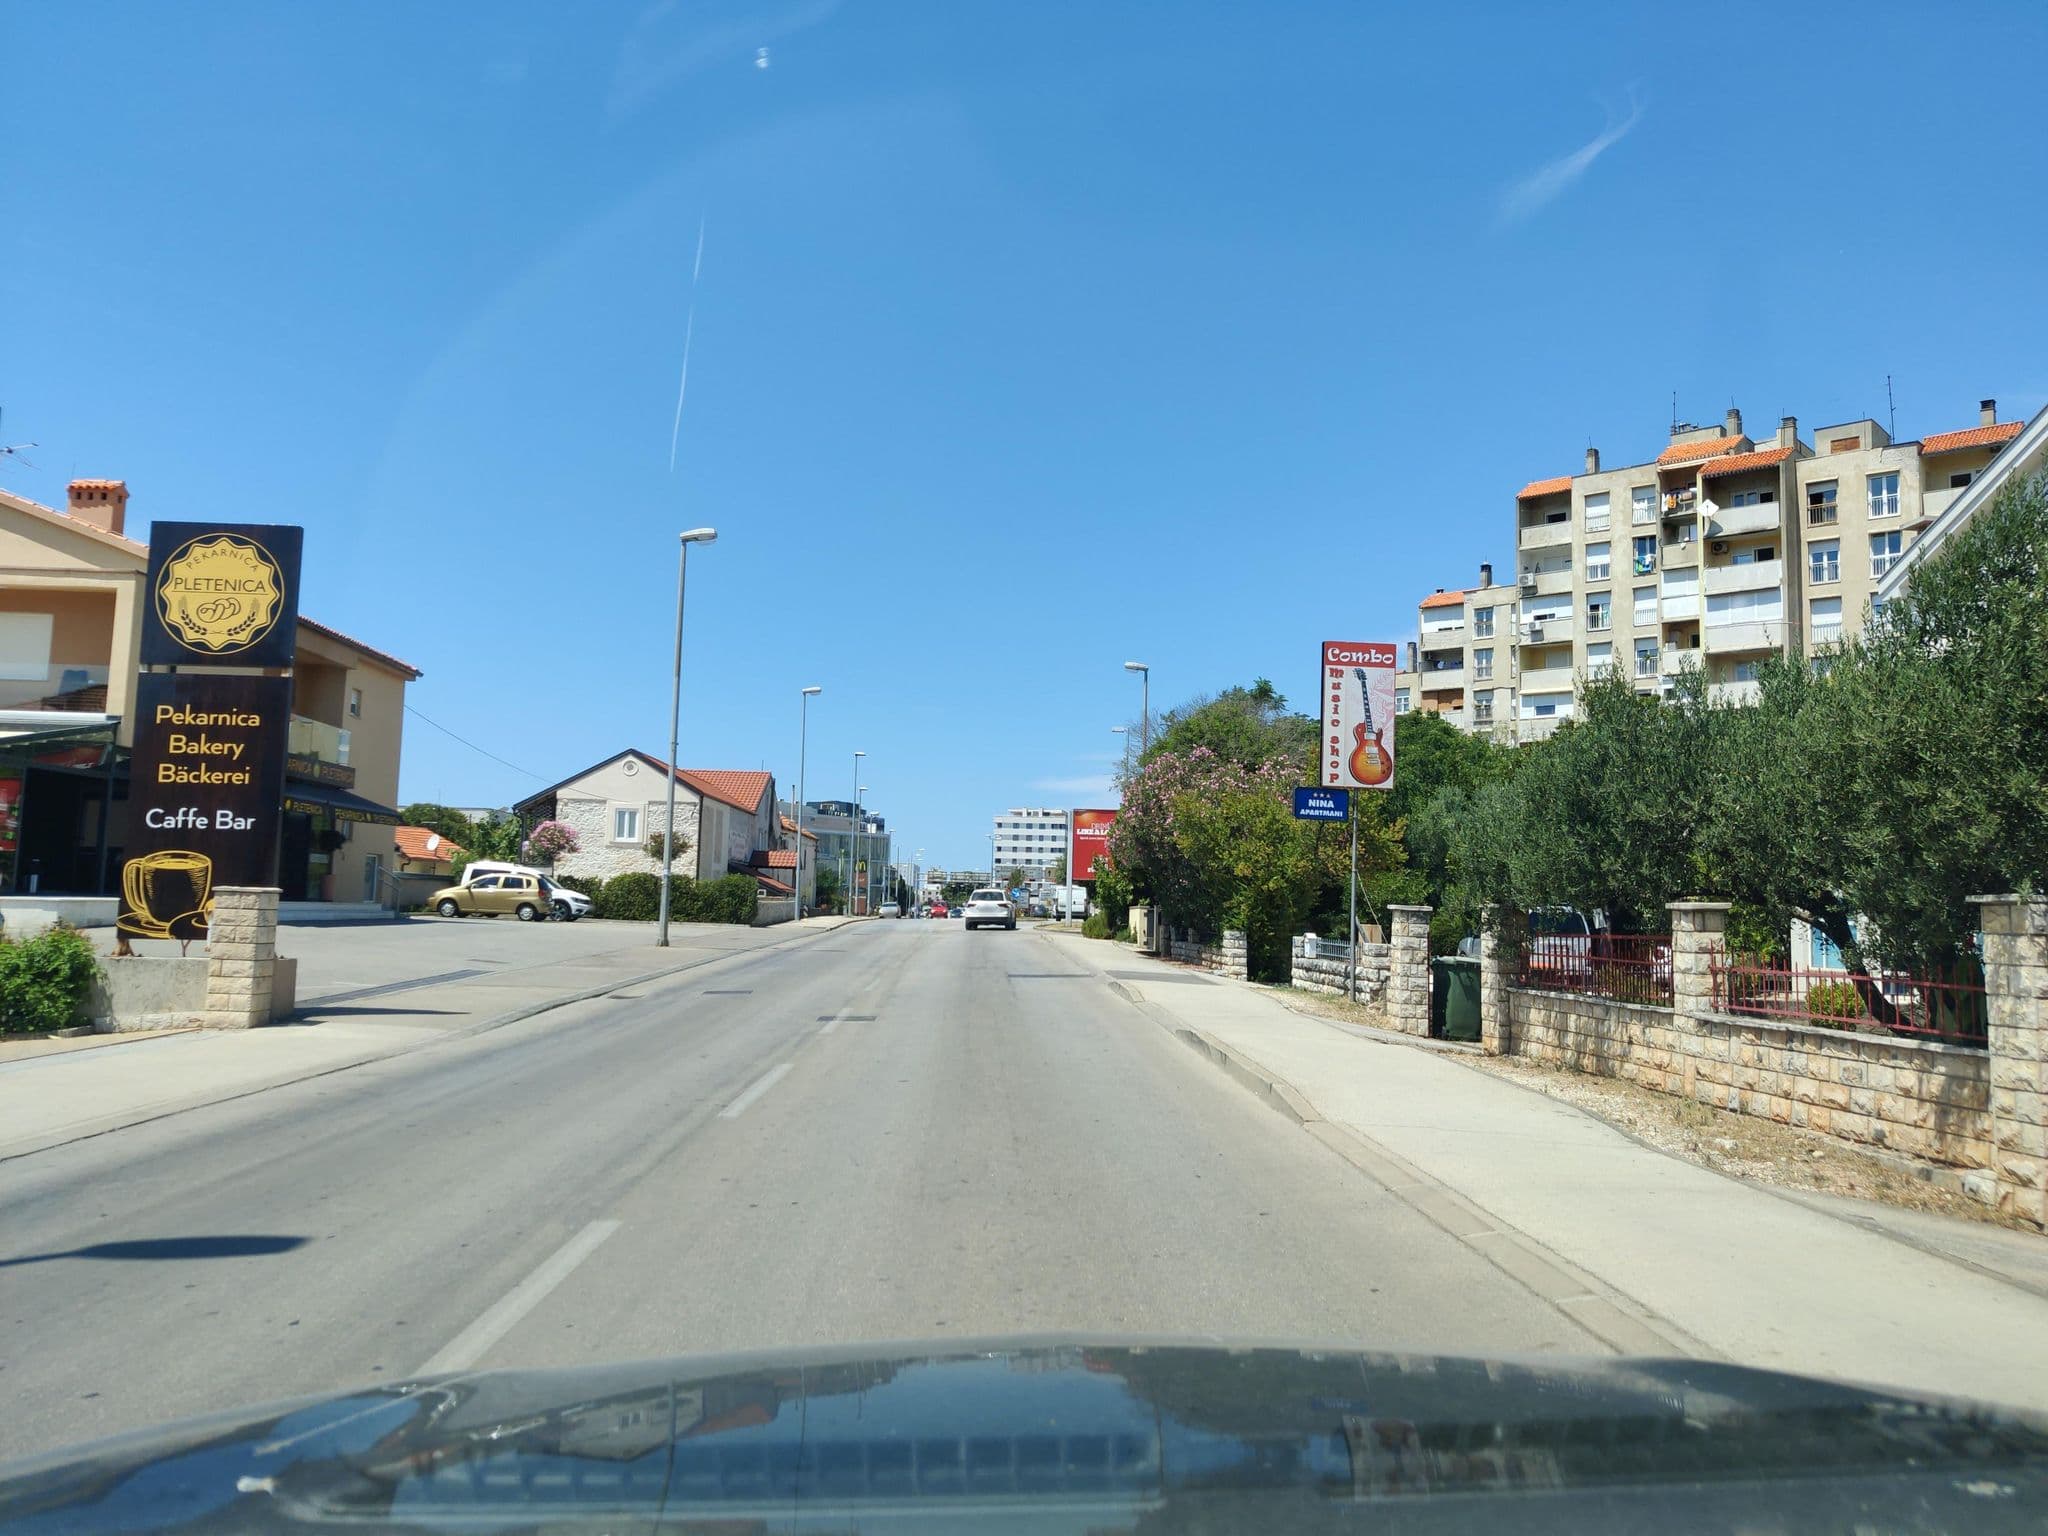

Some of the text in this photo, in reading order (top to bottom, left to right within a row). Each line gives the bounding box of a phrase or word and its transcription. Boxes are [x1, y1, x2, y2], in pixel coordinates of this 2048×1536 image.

[186, 548, 259, 572] PEKARNICA
[173, 577, 266, 593] PLETENICA
[1327, 647, 1394, 664] Combo
[155, 703, 261, 727] Pekarnica
[168, 733, 245, 760] Bakery
[157, 762, 251, 785] Bäckerei
[1299, 808, 1343, 817] APARTMANI
[1308, 798, 1334, 808] NINA
[145, 807, 257, 830] Caffe Bar
